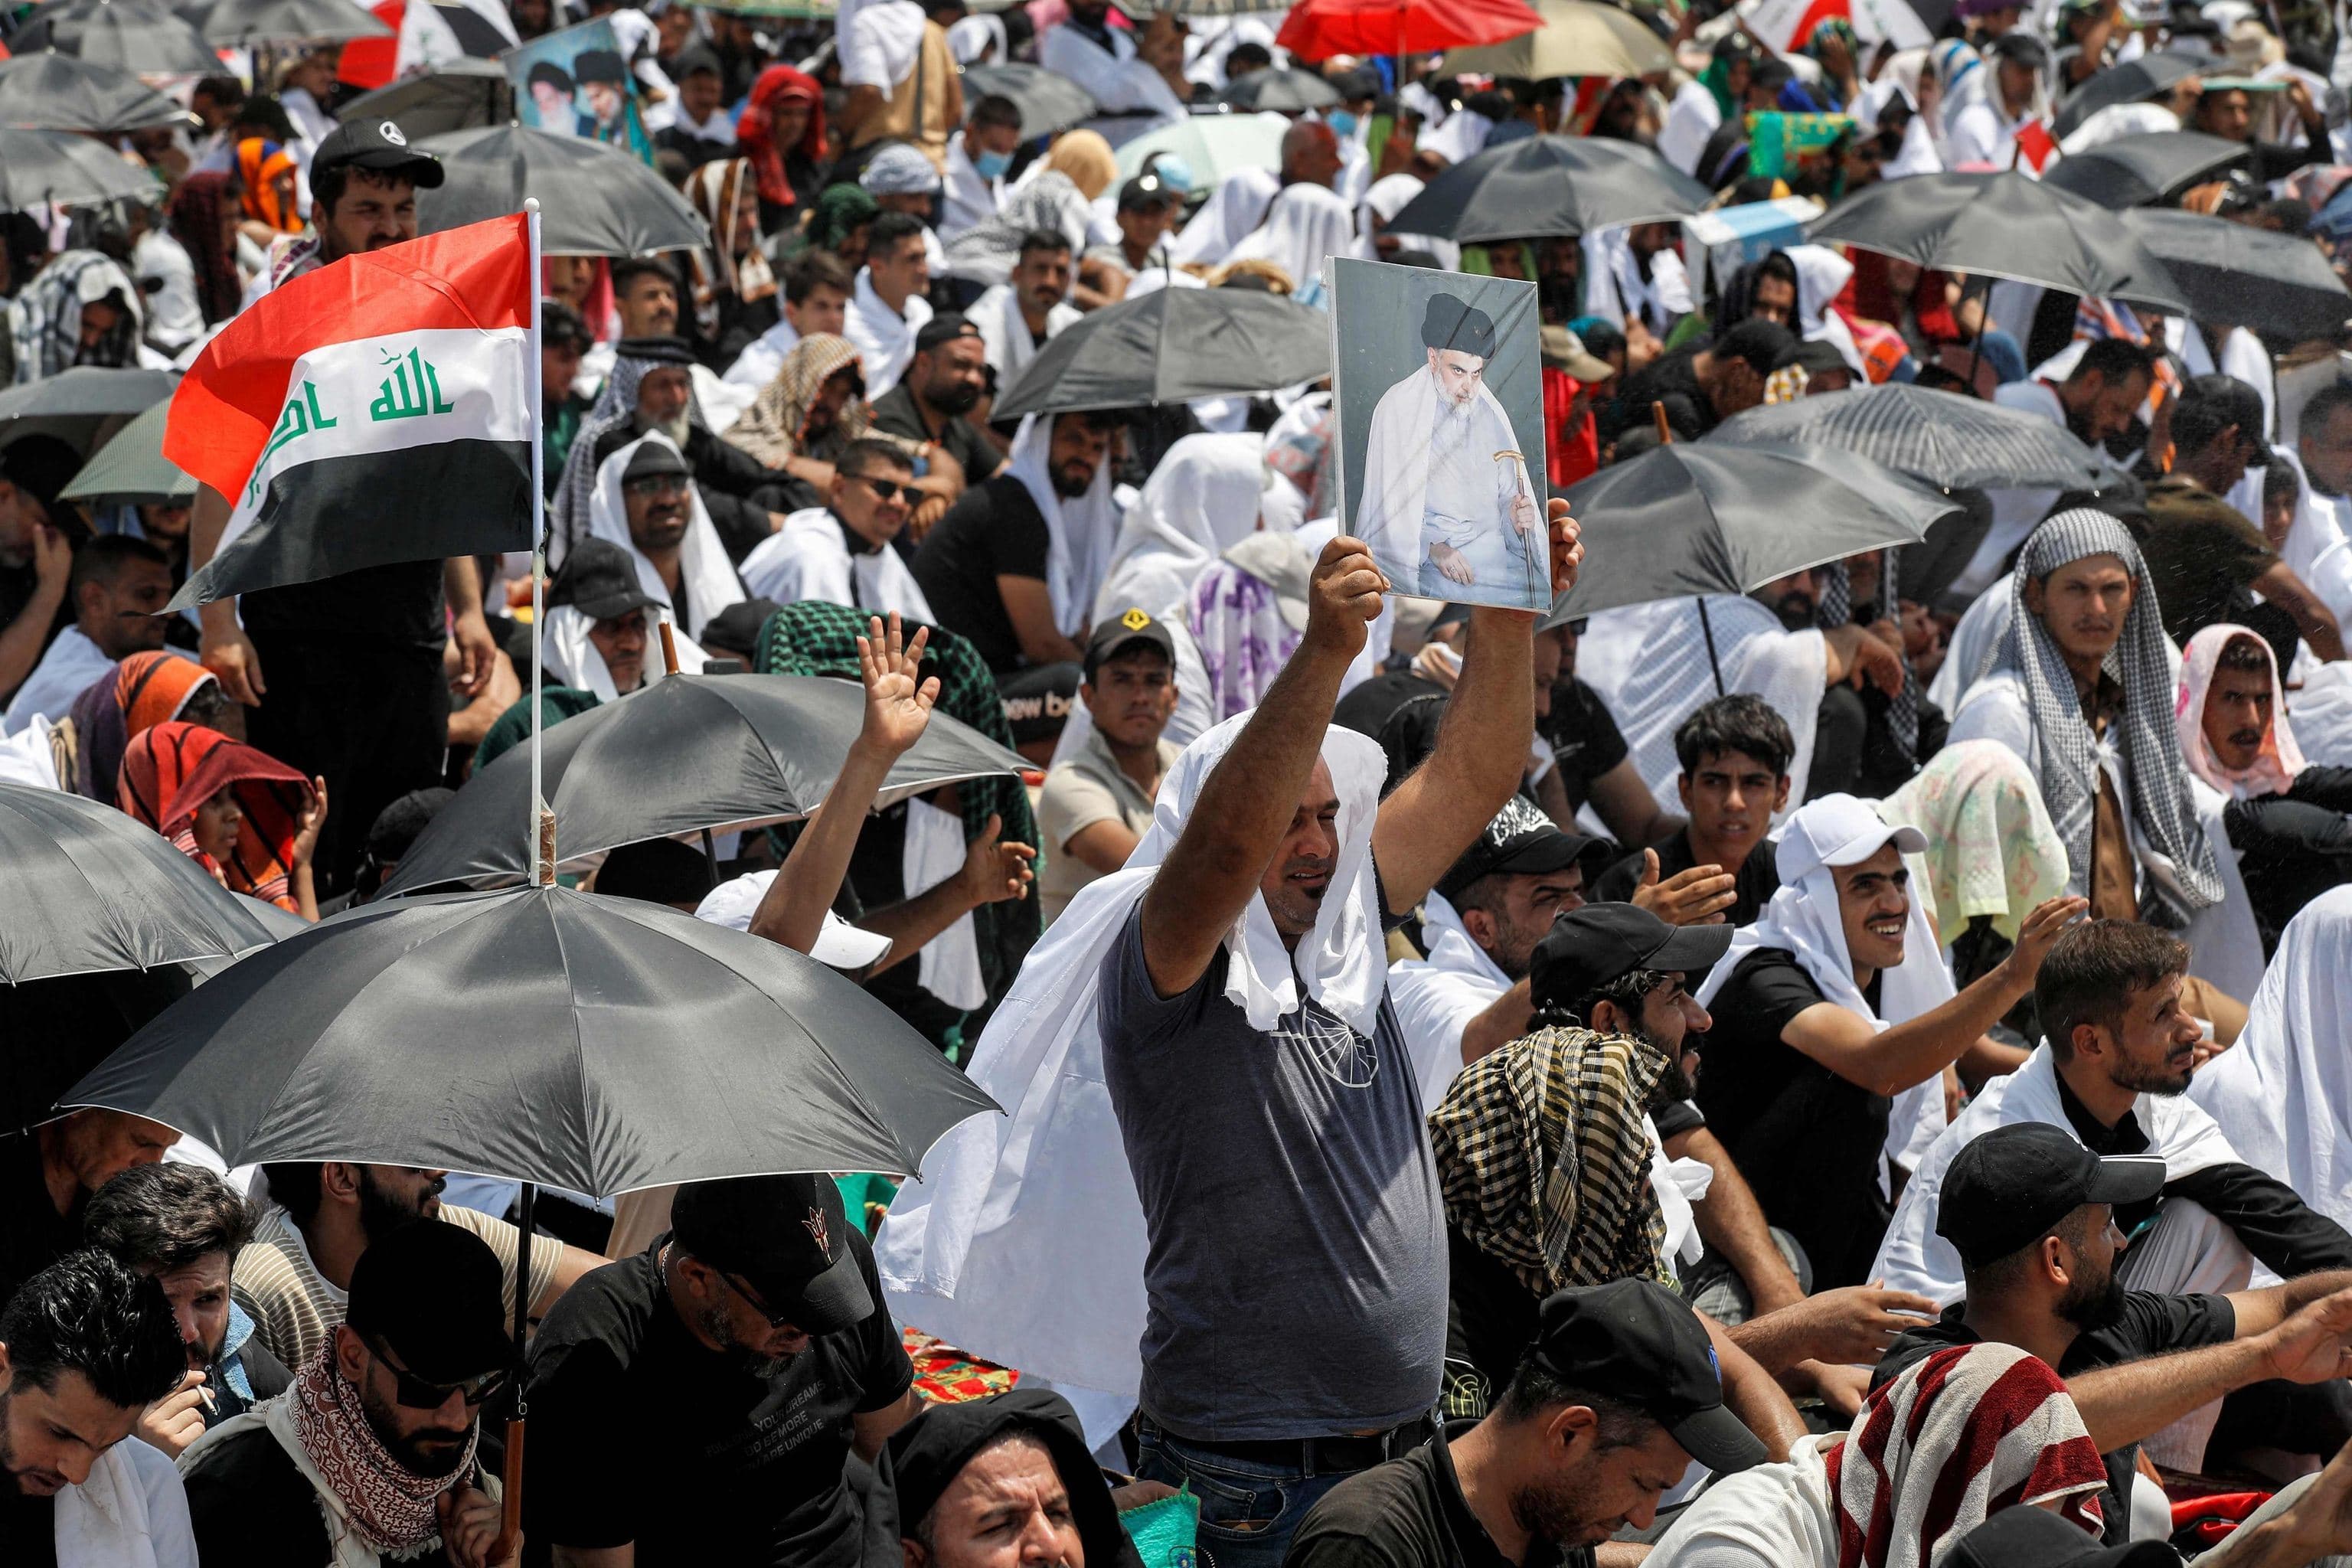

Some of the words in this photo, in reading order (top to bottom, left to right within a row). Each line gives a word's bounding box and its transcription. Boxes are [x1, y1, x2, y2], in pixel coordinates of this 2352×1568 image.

[754, 1410, 785, 1432] YOUR
[786, 1379, 827, 1414] DREAMS
[763, 1444, 785, 1465] ARE
[784, 1418, 825, 1451] UNIQUE
